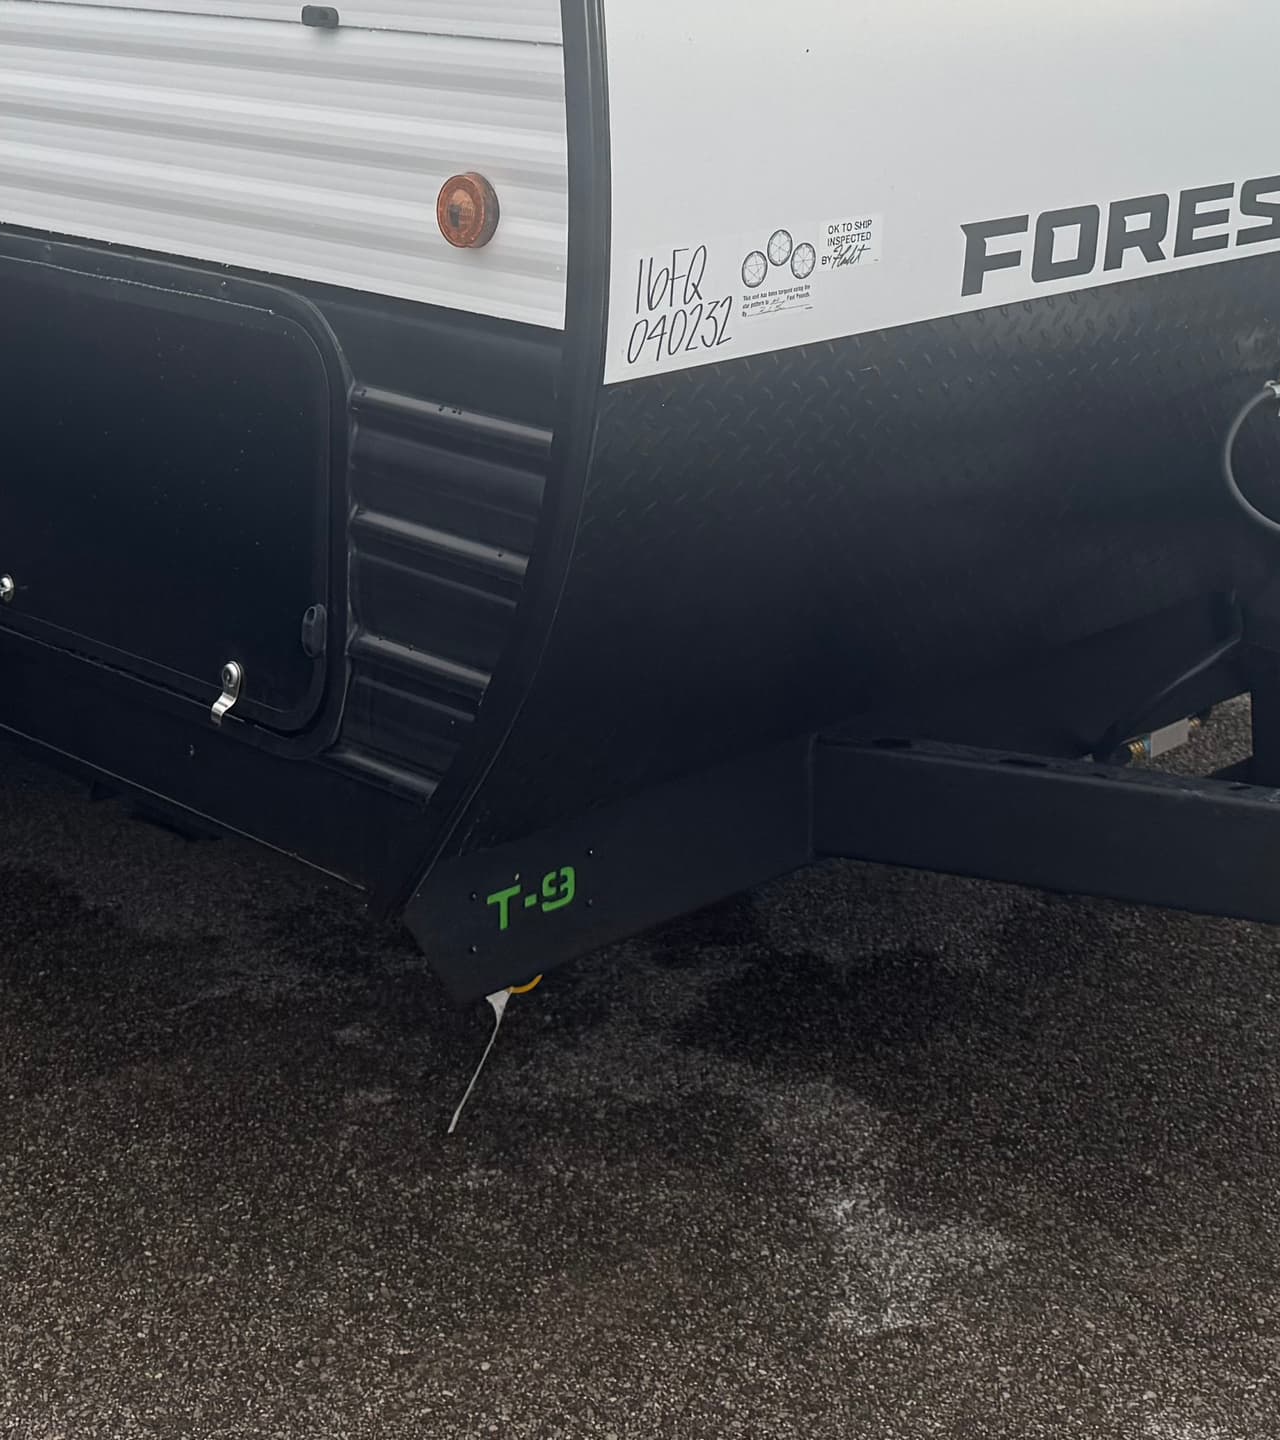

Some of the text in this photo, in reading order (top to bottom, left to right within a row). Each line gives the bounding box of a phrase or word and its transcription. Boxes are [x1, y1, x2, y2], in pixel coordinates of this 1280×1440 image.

[828, 219, 873, 235] OK TO SHIP
[827, 231, 872, 247] INSPECTED
[821, 255, 832, 265] BY
[627, 295, 732, 364] 040232
[486, 865, 576, 931] T-9
